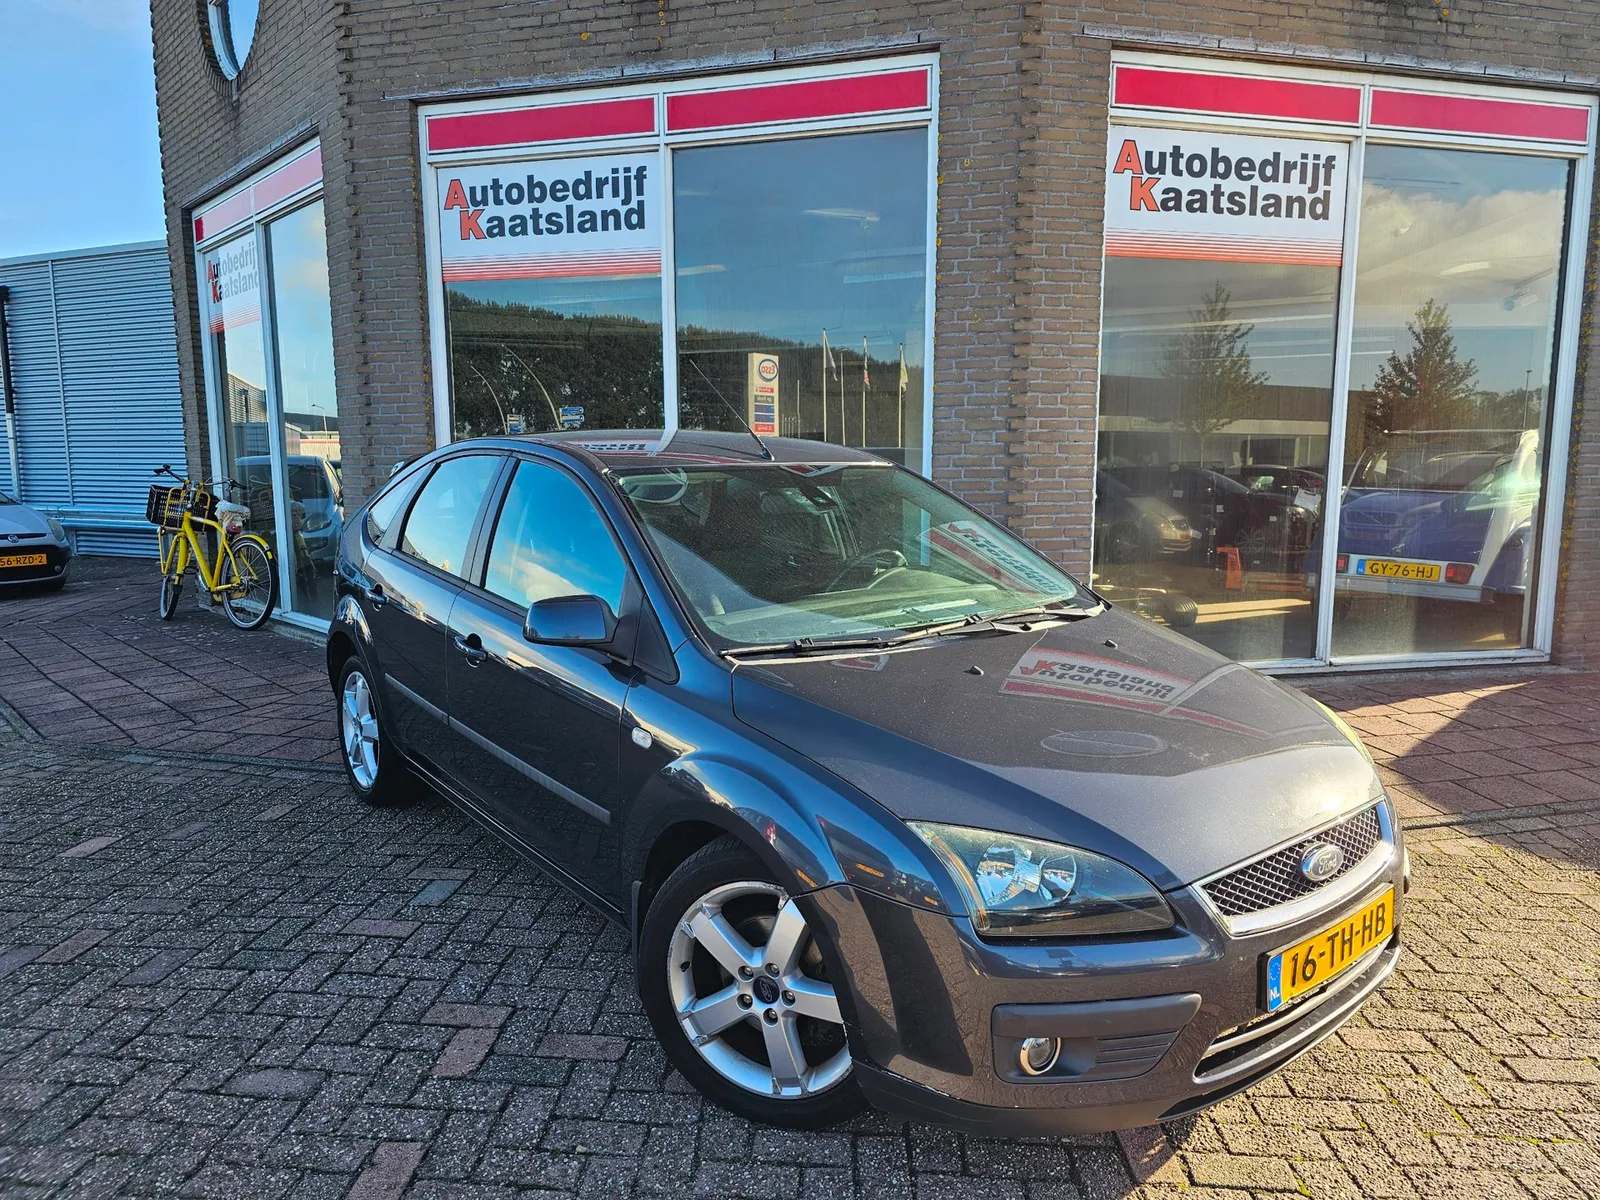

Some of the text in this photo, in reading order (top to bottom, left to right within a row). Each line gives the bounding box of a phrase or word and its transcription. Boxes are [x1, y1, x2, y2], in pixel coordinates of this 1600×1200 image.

[444, 165, 647, 210] Autobedrijf
[1113, 139, 1336, 194] Autobedrijf
[459, 199, 645, 240] Kaatsland
[1129, 175, 1331, 221] Kaatsland
[207, 240, 257, 283] Autobedrij
[0, 555, 44, 567] 56-RZD-2
[1369, 562, 1434, 579] GY-76-HJ
[1318, 853, 1338, 874] Ford
[1269, 901, 1386, 1000] NL 16-TH-HB
